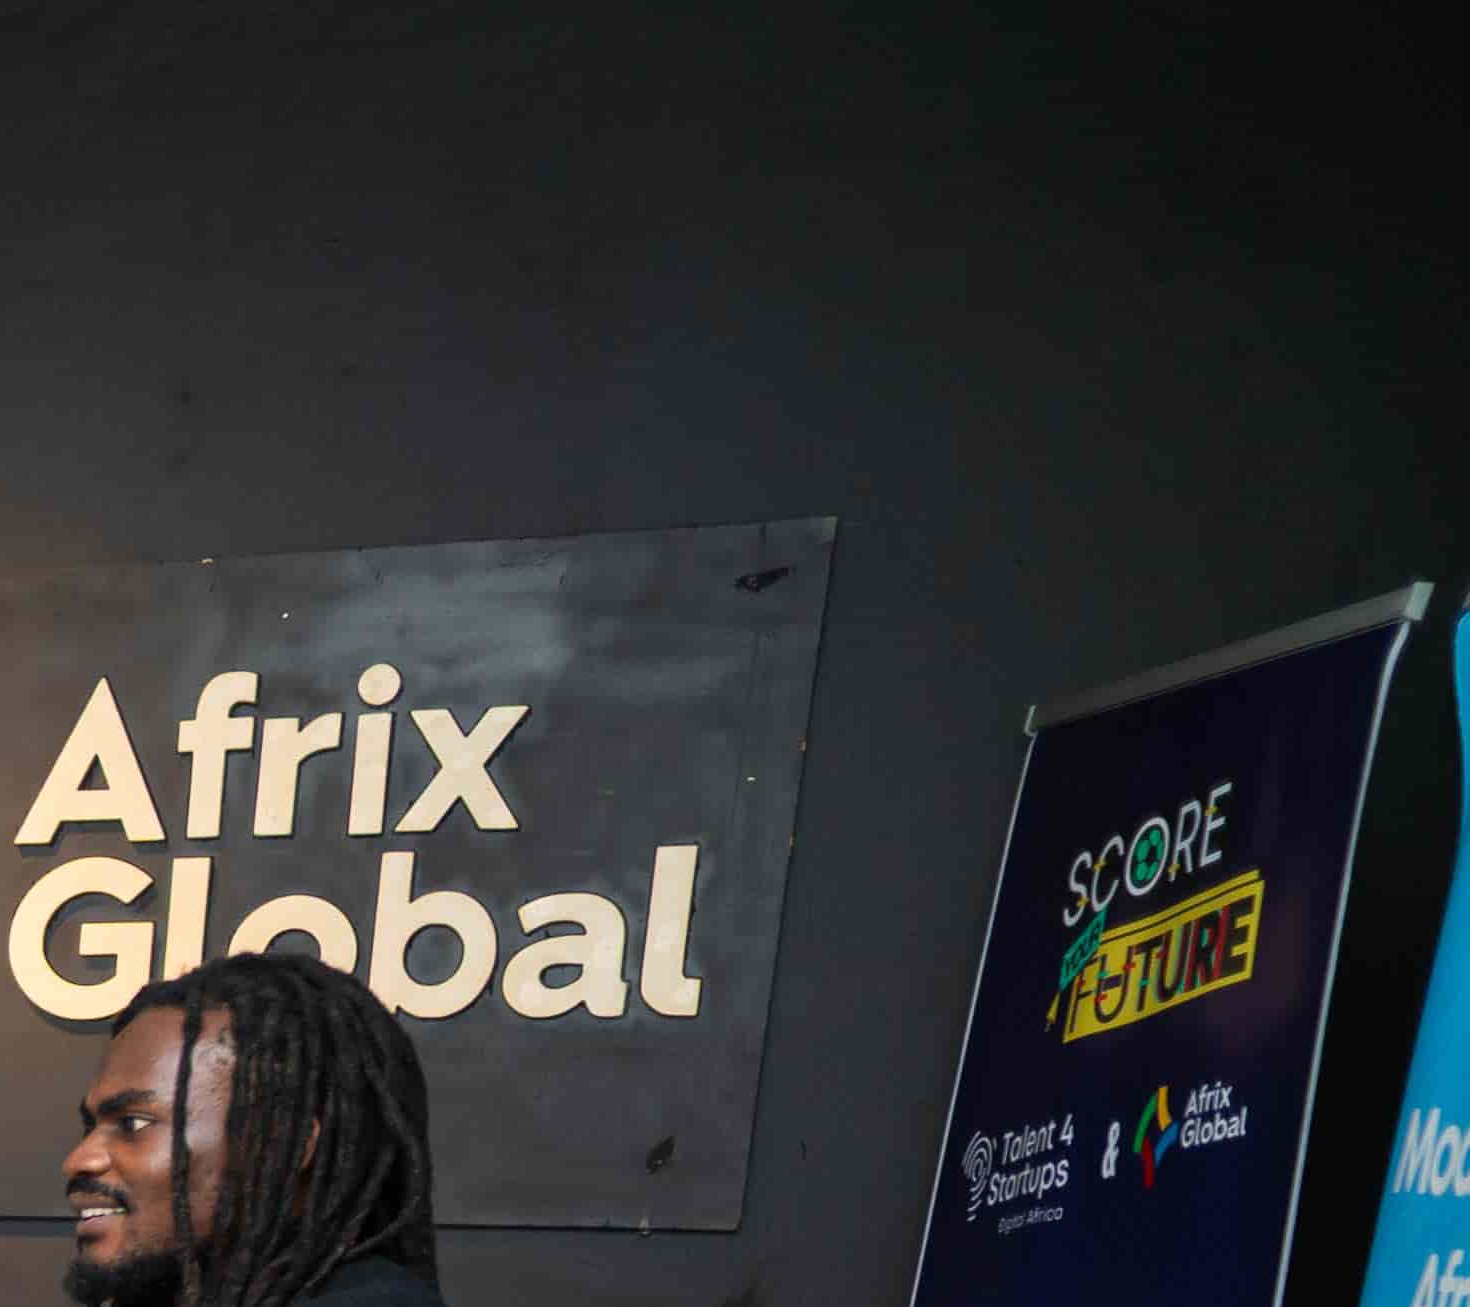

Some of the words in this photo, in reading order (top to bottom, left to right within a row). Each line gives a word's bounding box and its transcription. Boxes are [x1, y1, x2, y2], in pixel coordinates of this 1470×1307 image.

[13, 663, 530, 845] Afrix
[1063, 782, 1233, 927] SCORE
[8, 843, 702, 1021] Global
[1070, 894, 1256, 1033] FUTURE
[1002, 1120, 1057, 1165] Talent
[1060, 1113, 1073, 1146] 4
[1180, 1106, 1248, 1149] Global
[1184, 1081, 1233, 1118] Afrix
[987, 1159, 1070, 1206] Startups
